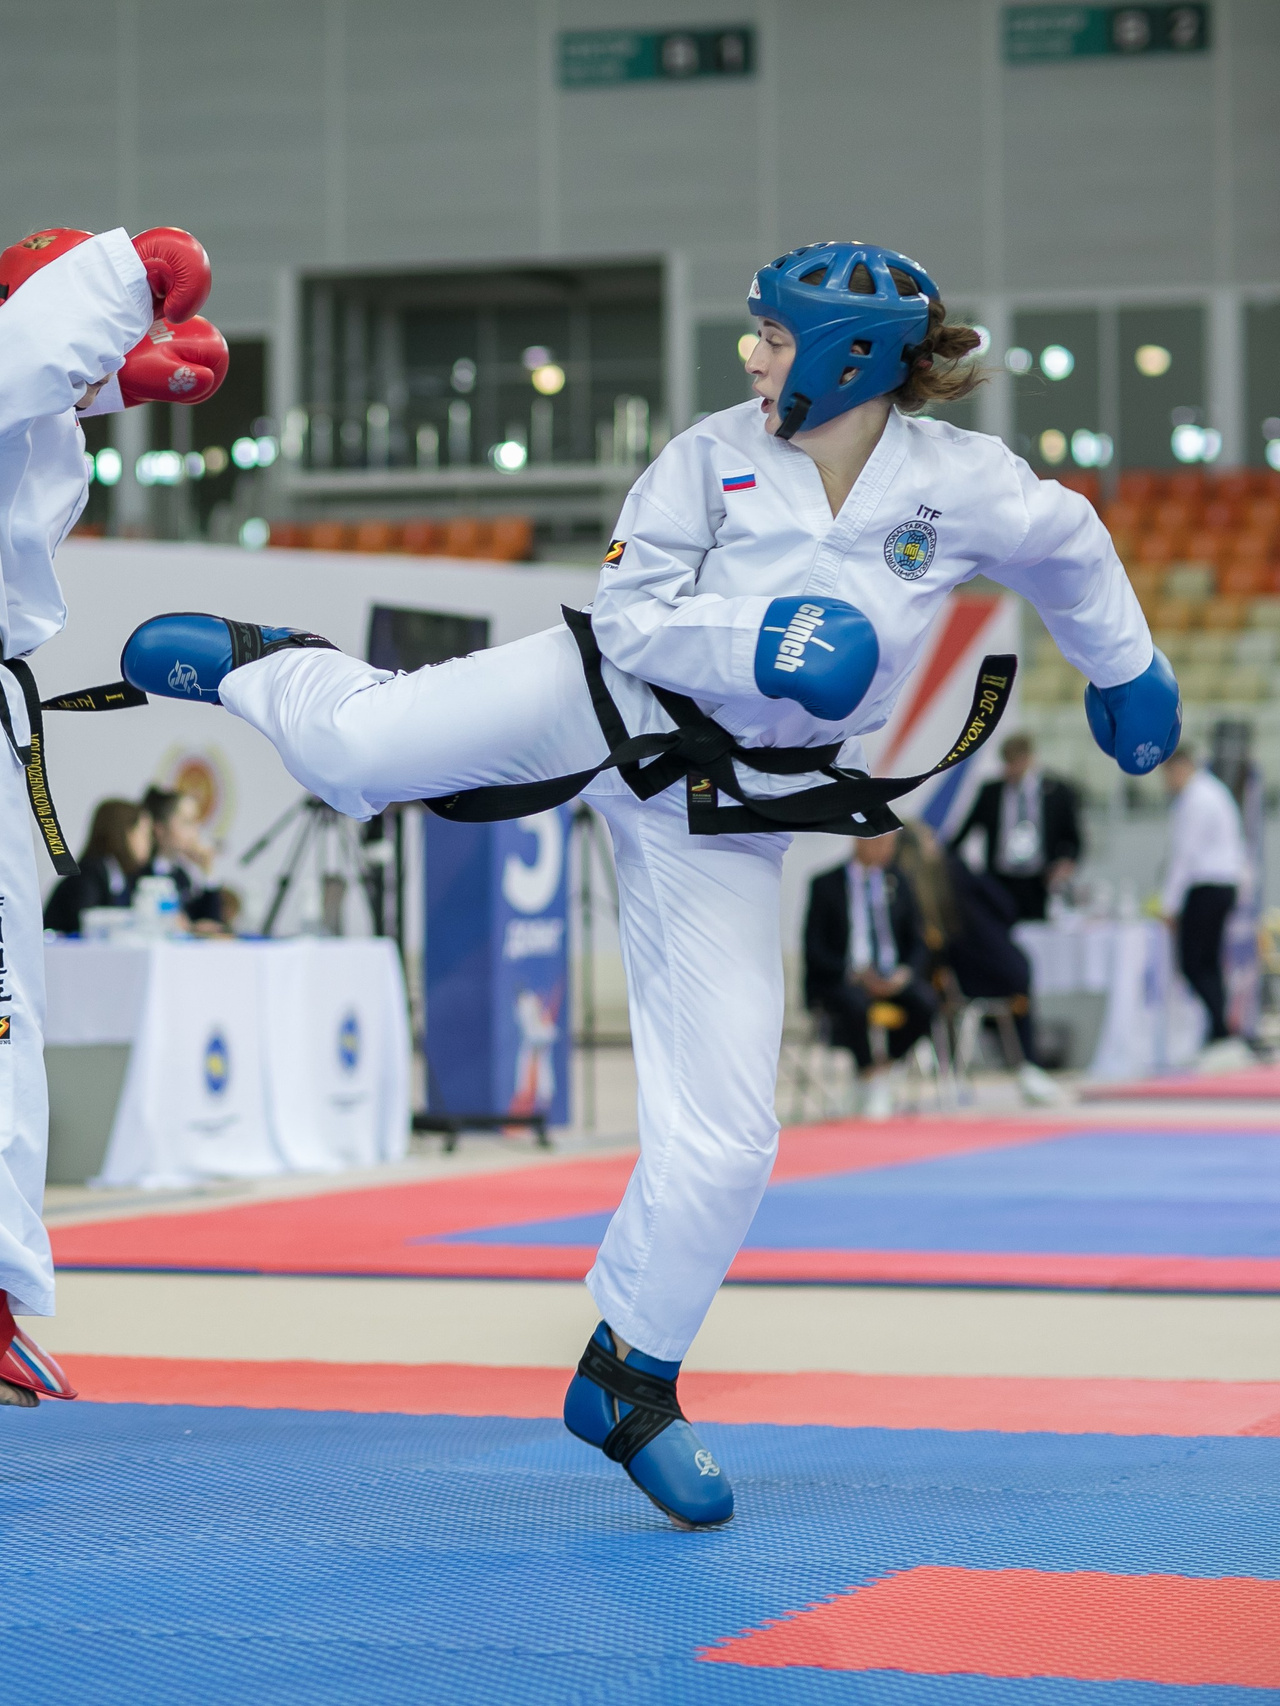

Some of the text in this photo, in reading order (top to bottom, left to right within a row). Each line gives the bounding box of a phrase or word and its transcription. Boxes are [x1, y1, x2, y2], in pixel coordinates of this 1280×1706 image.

[916, 504, 942, 521] ITF
[774, 603, 825, 673] clinch
[41, 817, 66, 855] EVDOKIA
